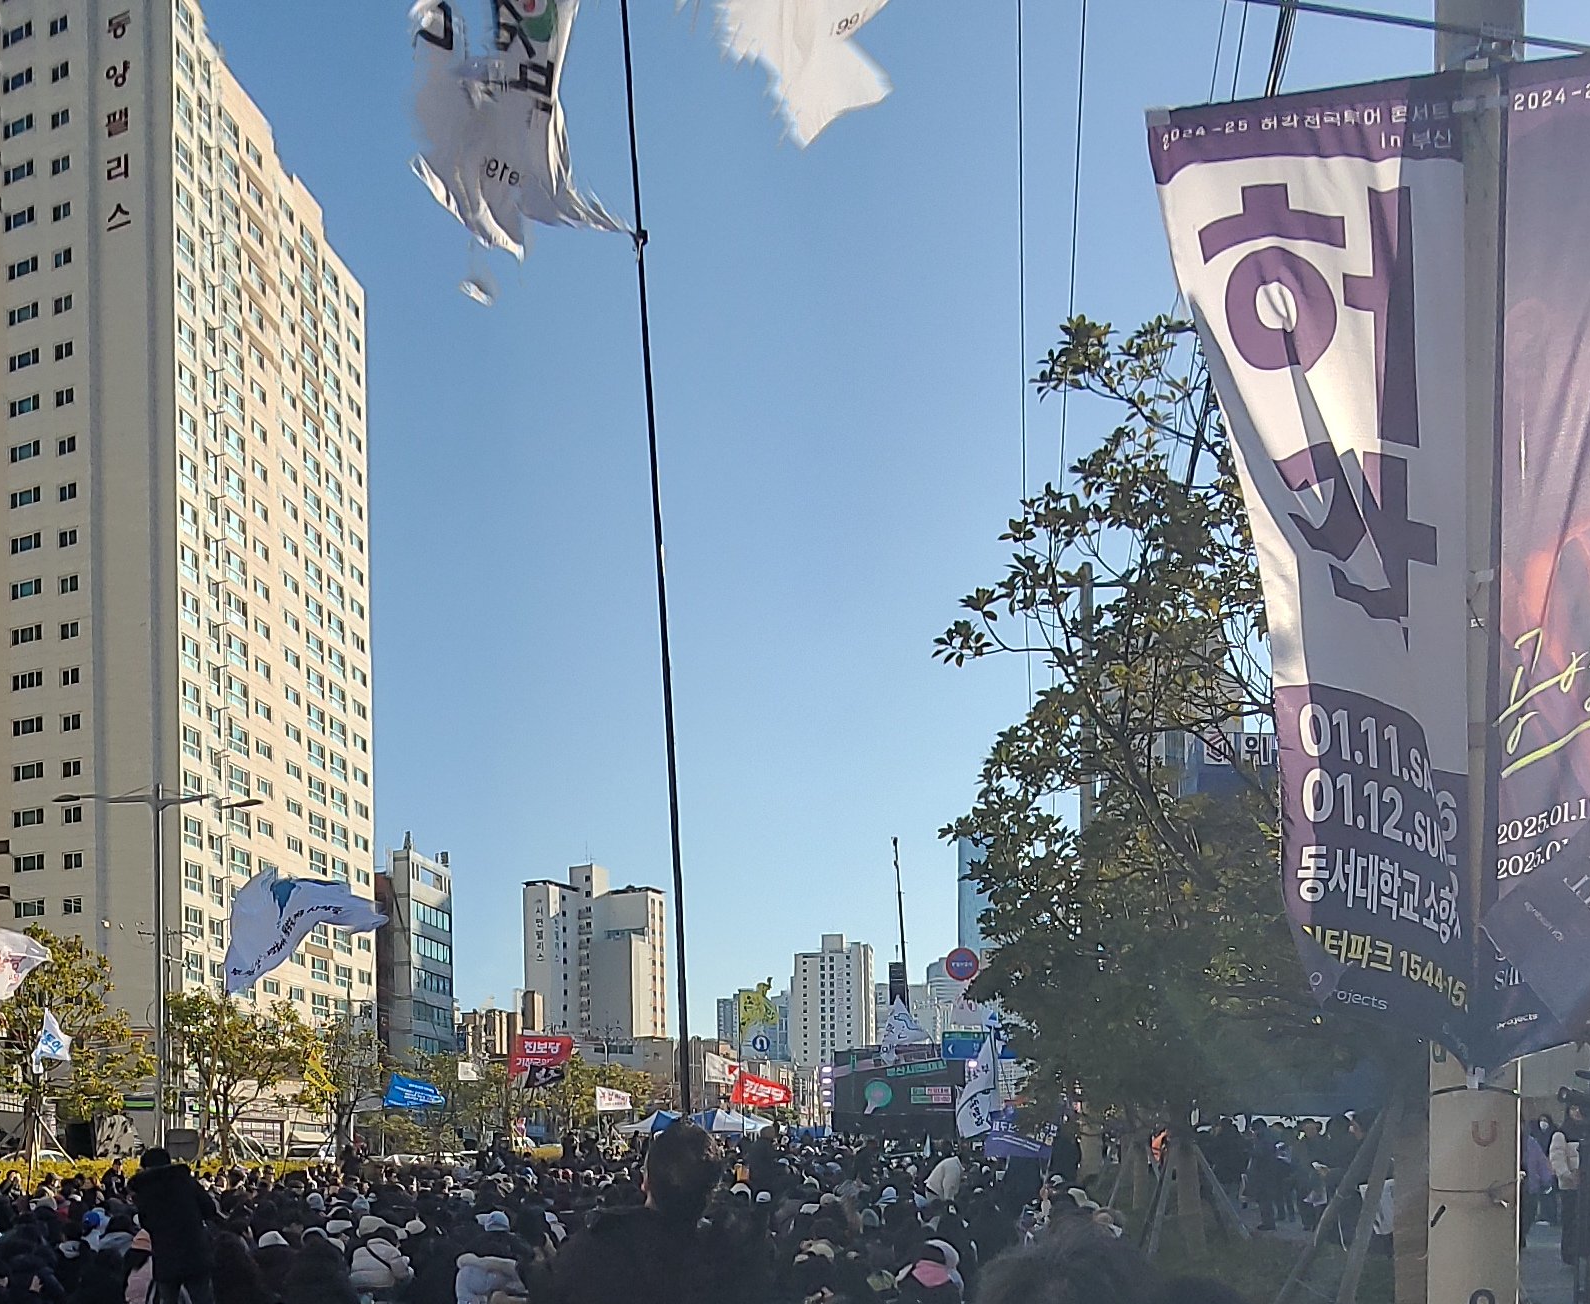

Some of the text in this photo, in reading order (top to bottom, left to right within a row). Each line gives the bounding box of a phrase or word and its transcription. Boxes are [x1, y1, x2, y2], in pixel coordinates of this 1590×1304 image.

[1380, 126, 1454, 150] in 부산
[1297, 702, 1435, 797] 01.11.SA
[1295, 843, 1421, 925] 동서대학교
[523, 1039, 561, 1056] 진보당
[743, 1077, 785, 1102] 진보당
